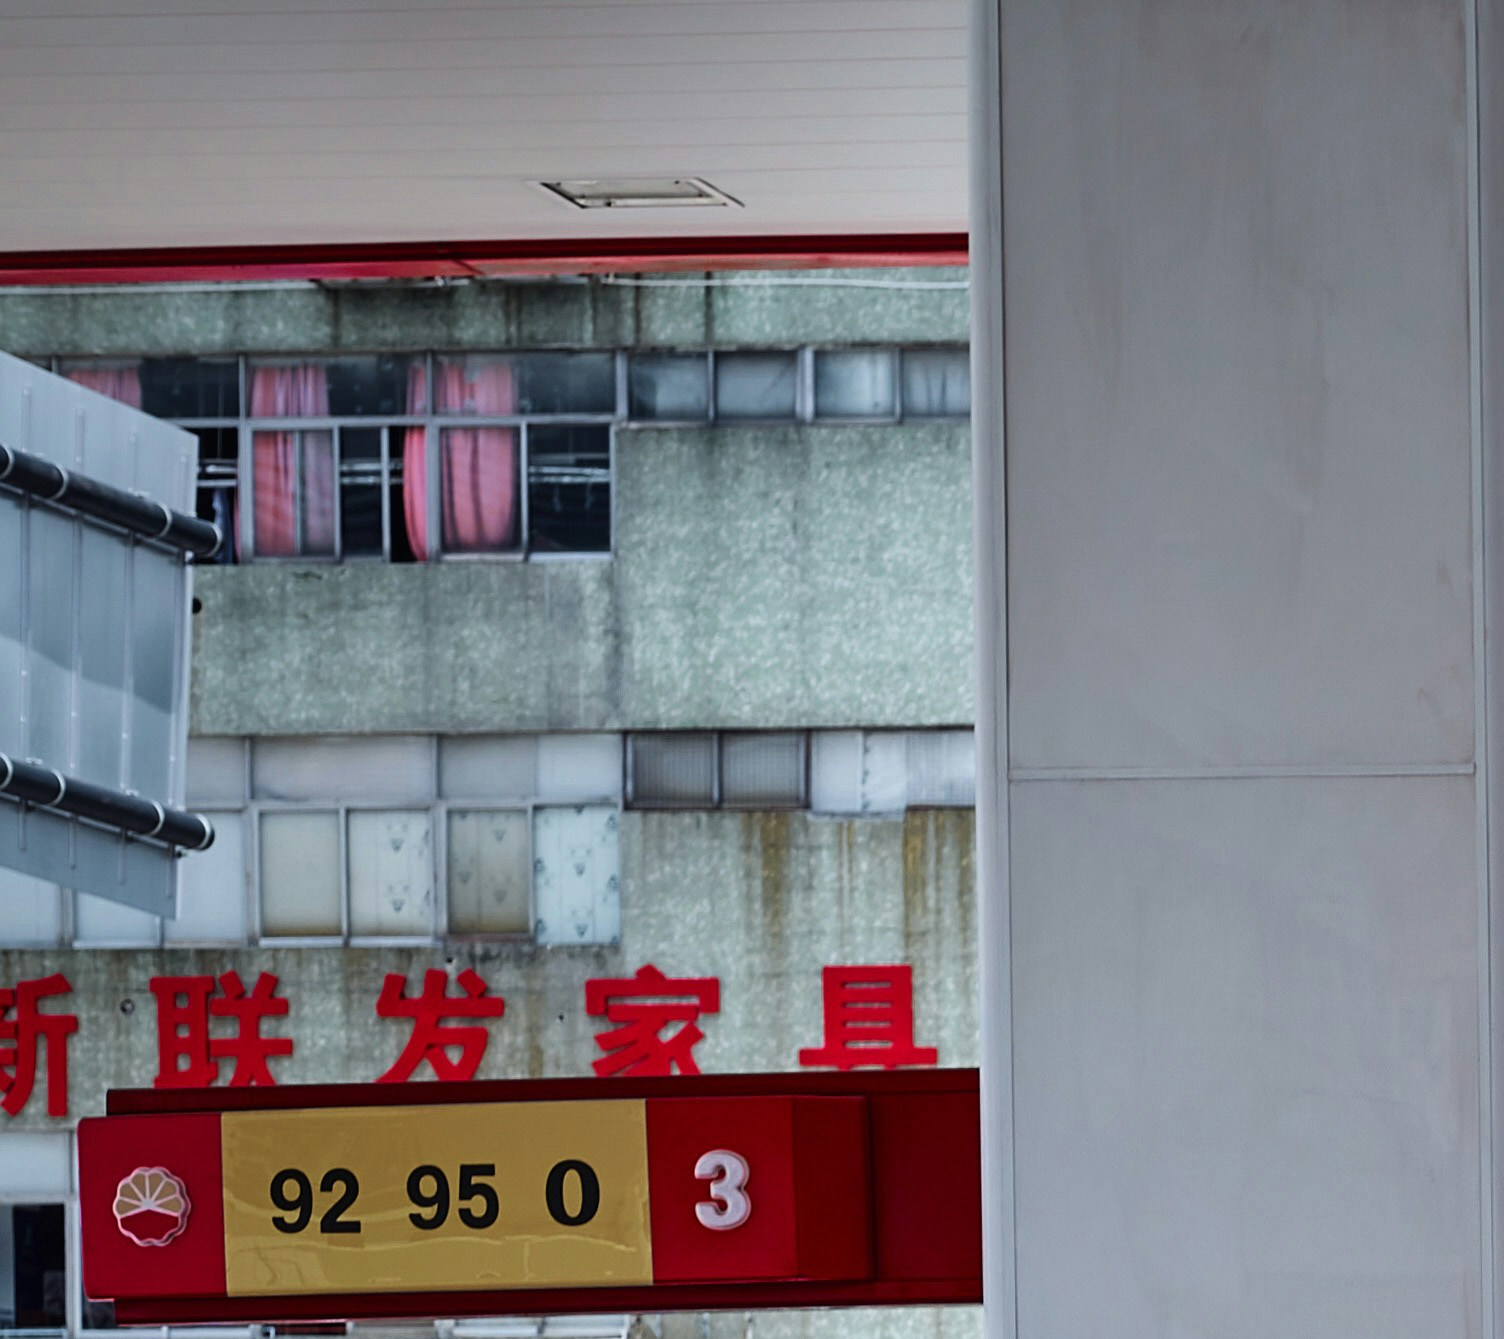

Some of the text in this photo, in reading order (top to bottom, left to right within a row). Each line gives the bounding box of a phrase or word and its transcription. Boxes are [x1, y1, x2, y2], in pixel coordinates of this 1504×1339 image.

[269, 1148, 752, 1234] 92 95 0 3
